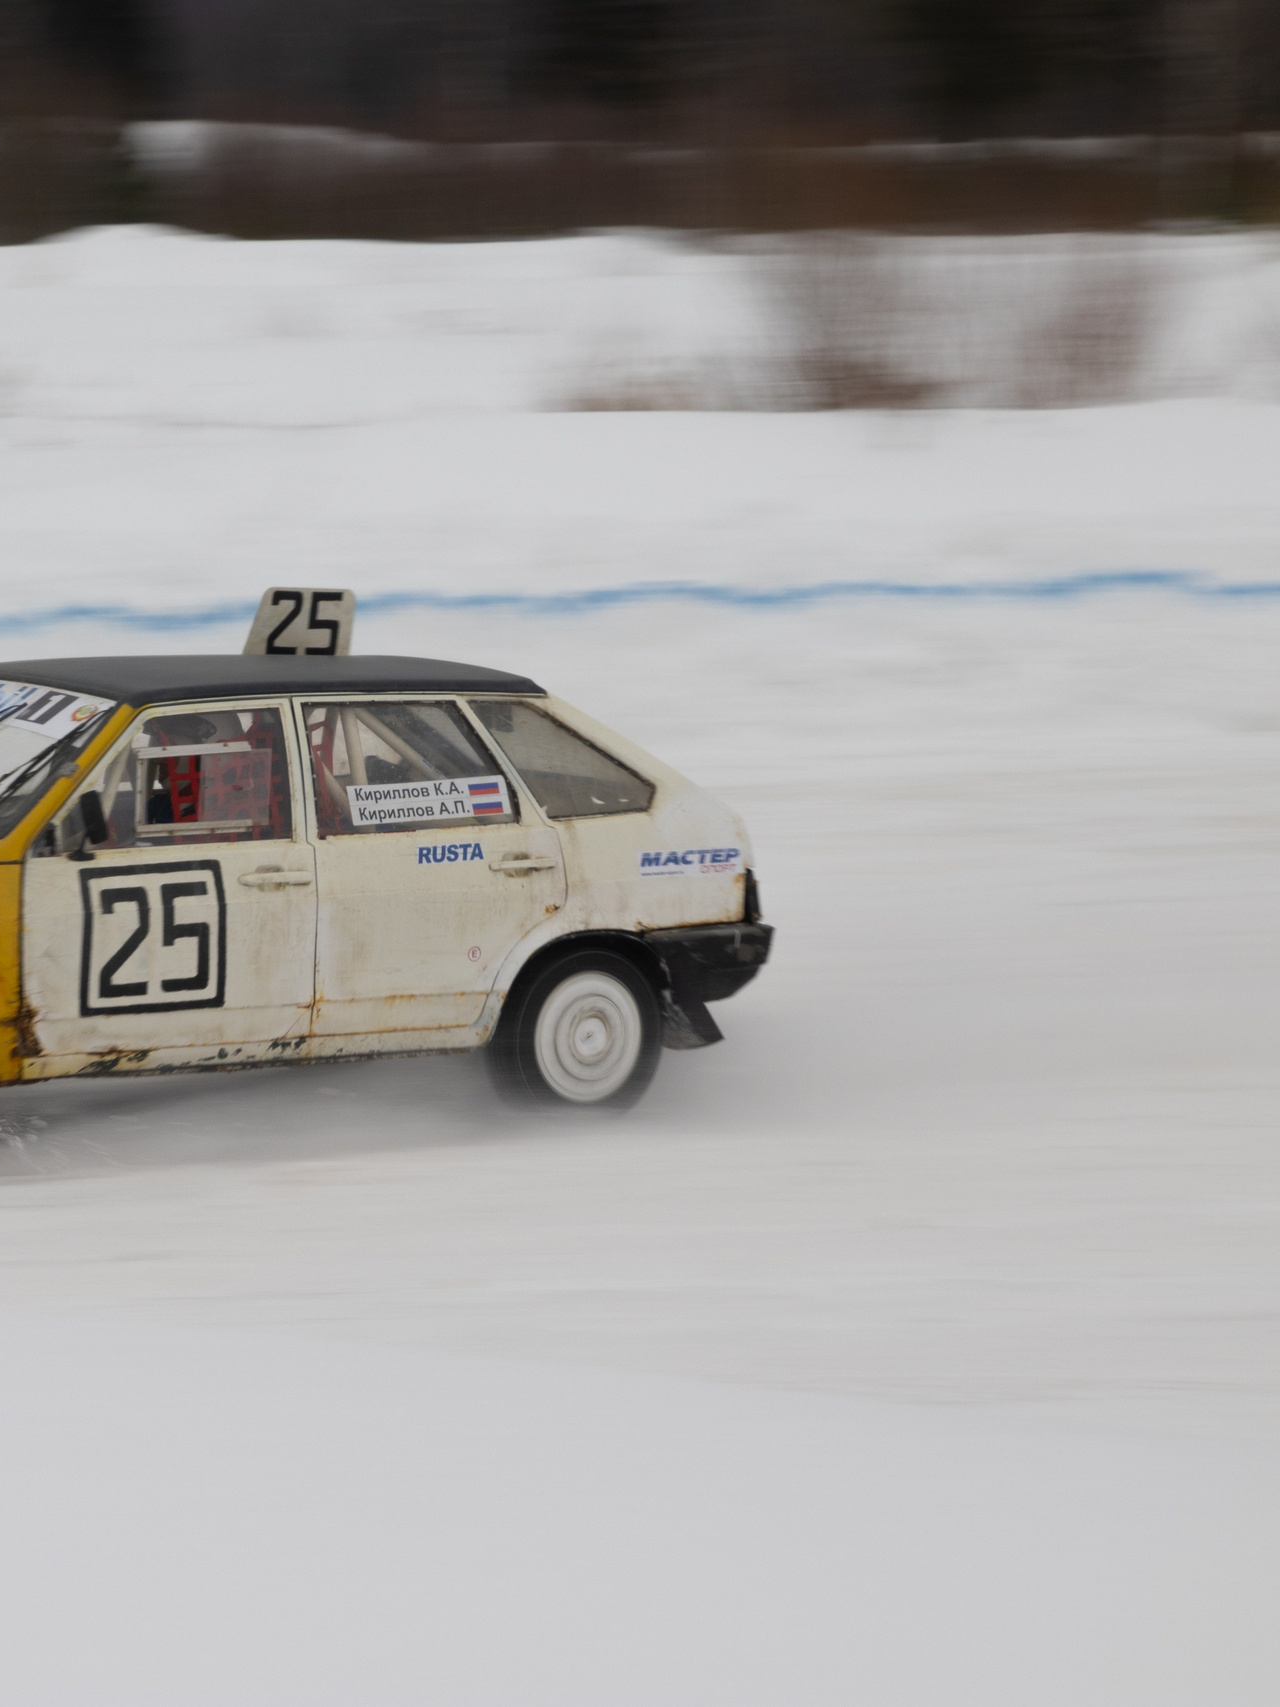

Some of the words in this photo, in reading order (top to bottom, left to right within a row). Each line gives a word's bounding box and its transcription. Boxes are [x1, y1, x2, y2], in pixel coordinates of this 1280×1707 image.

[266, 590, 344, 656] 25
[24, 692, 70, 723] 1
[354, 787, 430, 804] Кириллов
[434, 782, 465, 797] К.А.
[358, 805, 435, 823] Кириллов
[439, 801, 471, 816] А.П.
[417, 843, 484, 865] RUSTA
[640, 848, 740, 868] МАСТЕР
[99, 881, 210, 999] 25
